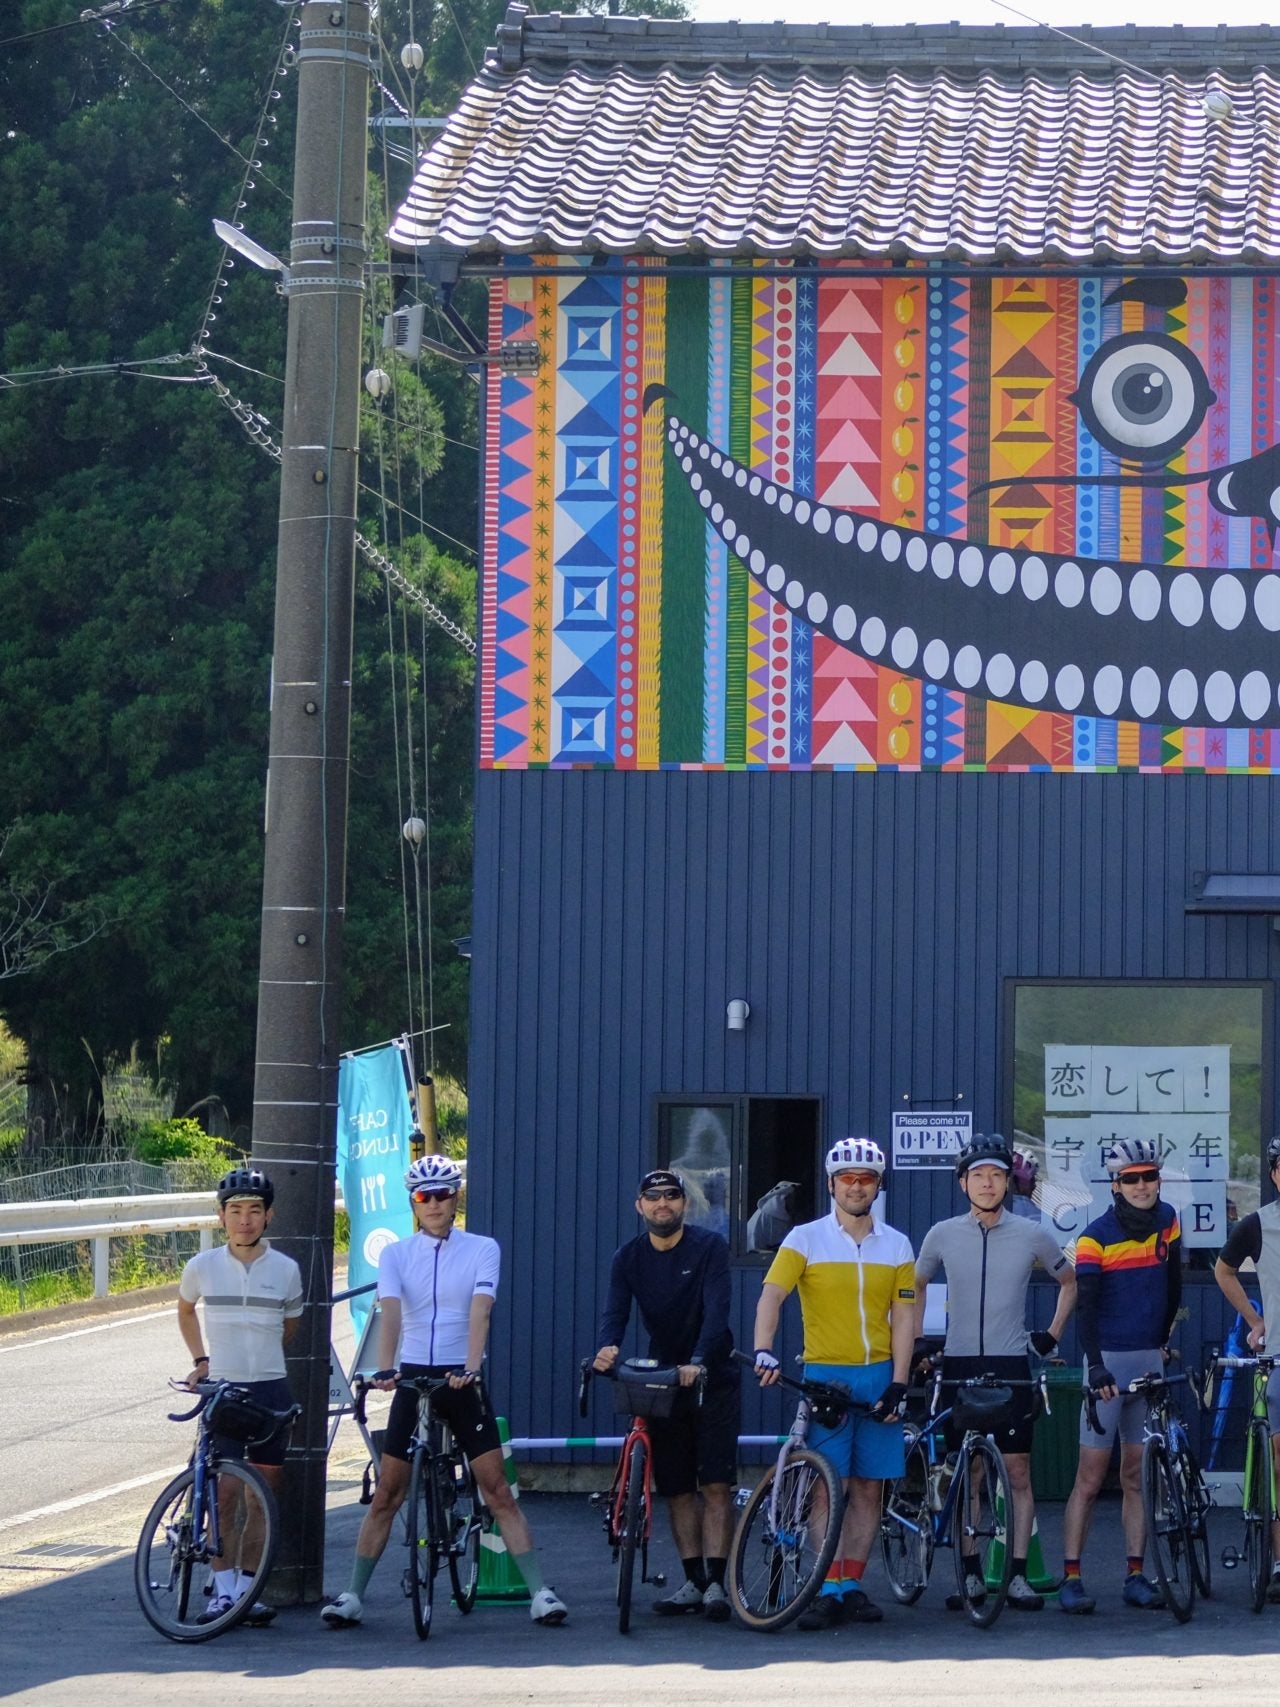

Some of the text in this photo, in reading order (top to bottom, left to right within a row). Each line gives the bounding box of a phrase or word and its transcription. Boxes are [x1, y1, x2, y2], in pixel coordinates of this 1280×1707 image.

[899, 1116, 928, 1126] Please
[929, 1117, 954, 1126] come
[1052, 1202, 1216, 1233] CE
